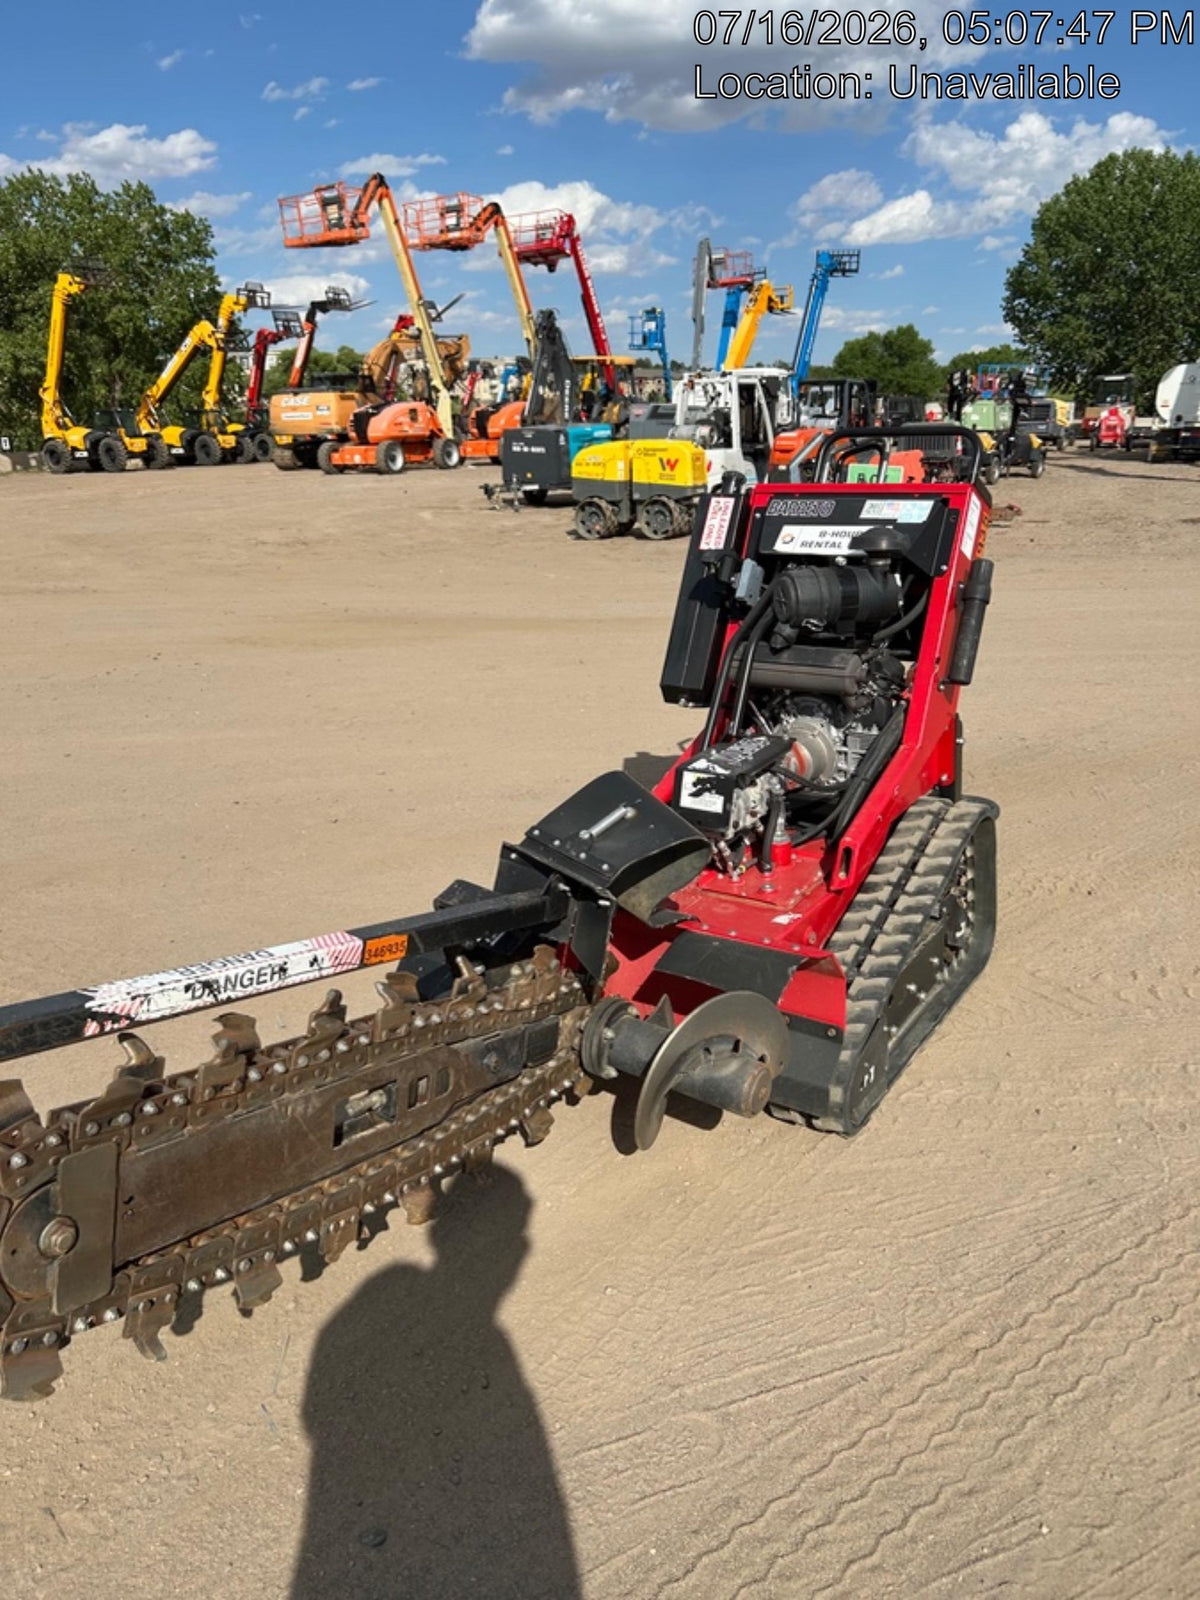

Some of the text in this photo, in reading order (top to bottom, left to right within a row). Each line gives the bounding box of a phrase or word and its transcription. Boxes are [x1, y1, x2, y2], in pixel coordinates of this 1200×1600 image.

[766, 499, 836, 517] BARRETO
[703, 500, 721, 546] FUEL ONLY
[714, 500, 732, 548] UNLEADED
[800, 539, 842, 549] RENTAL
[366, 940, 407, 962] 346935
